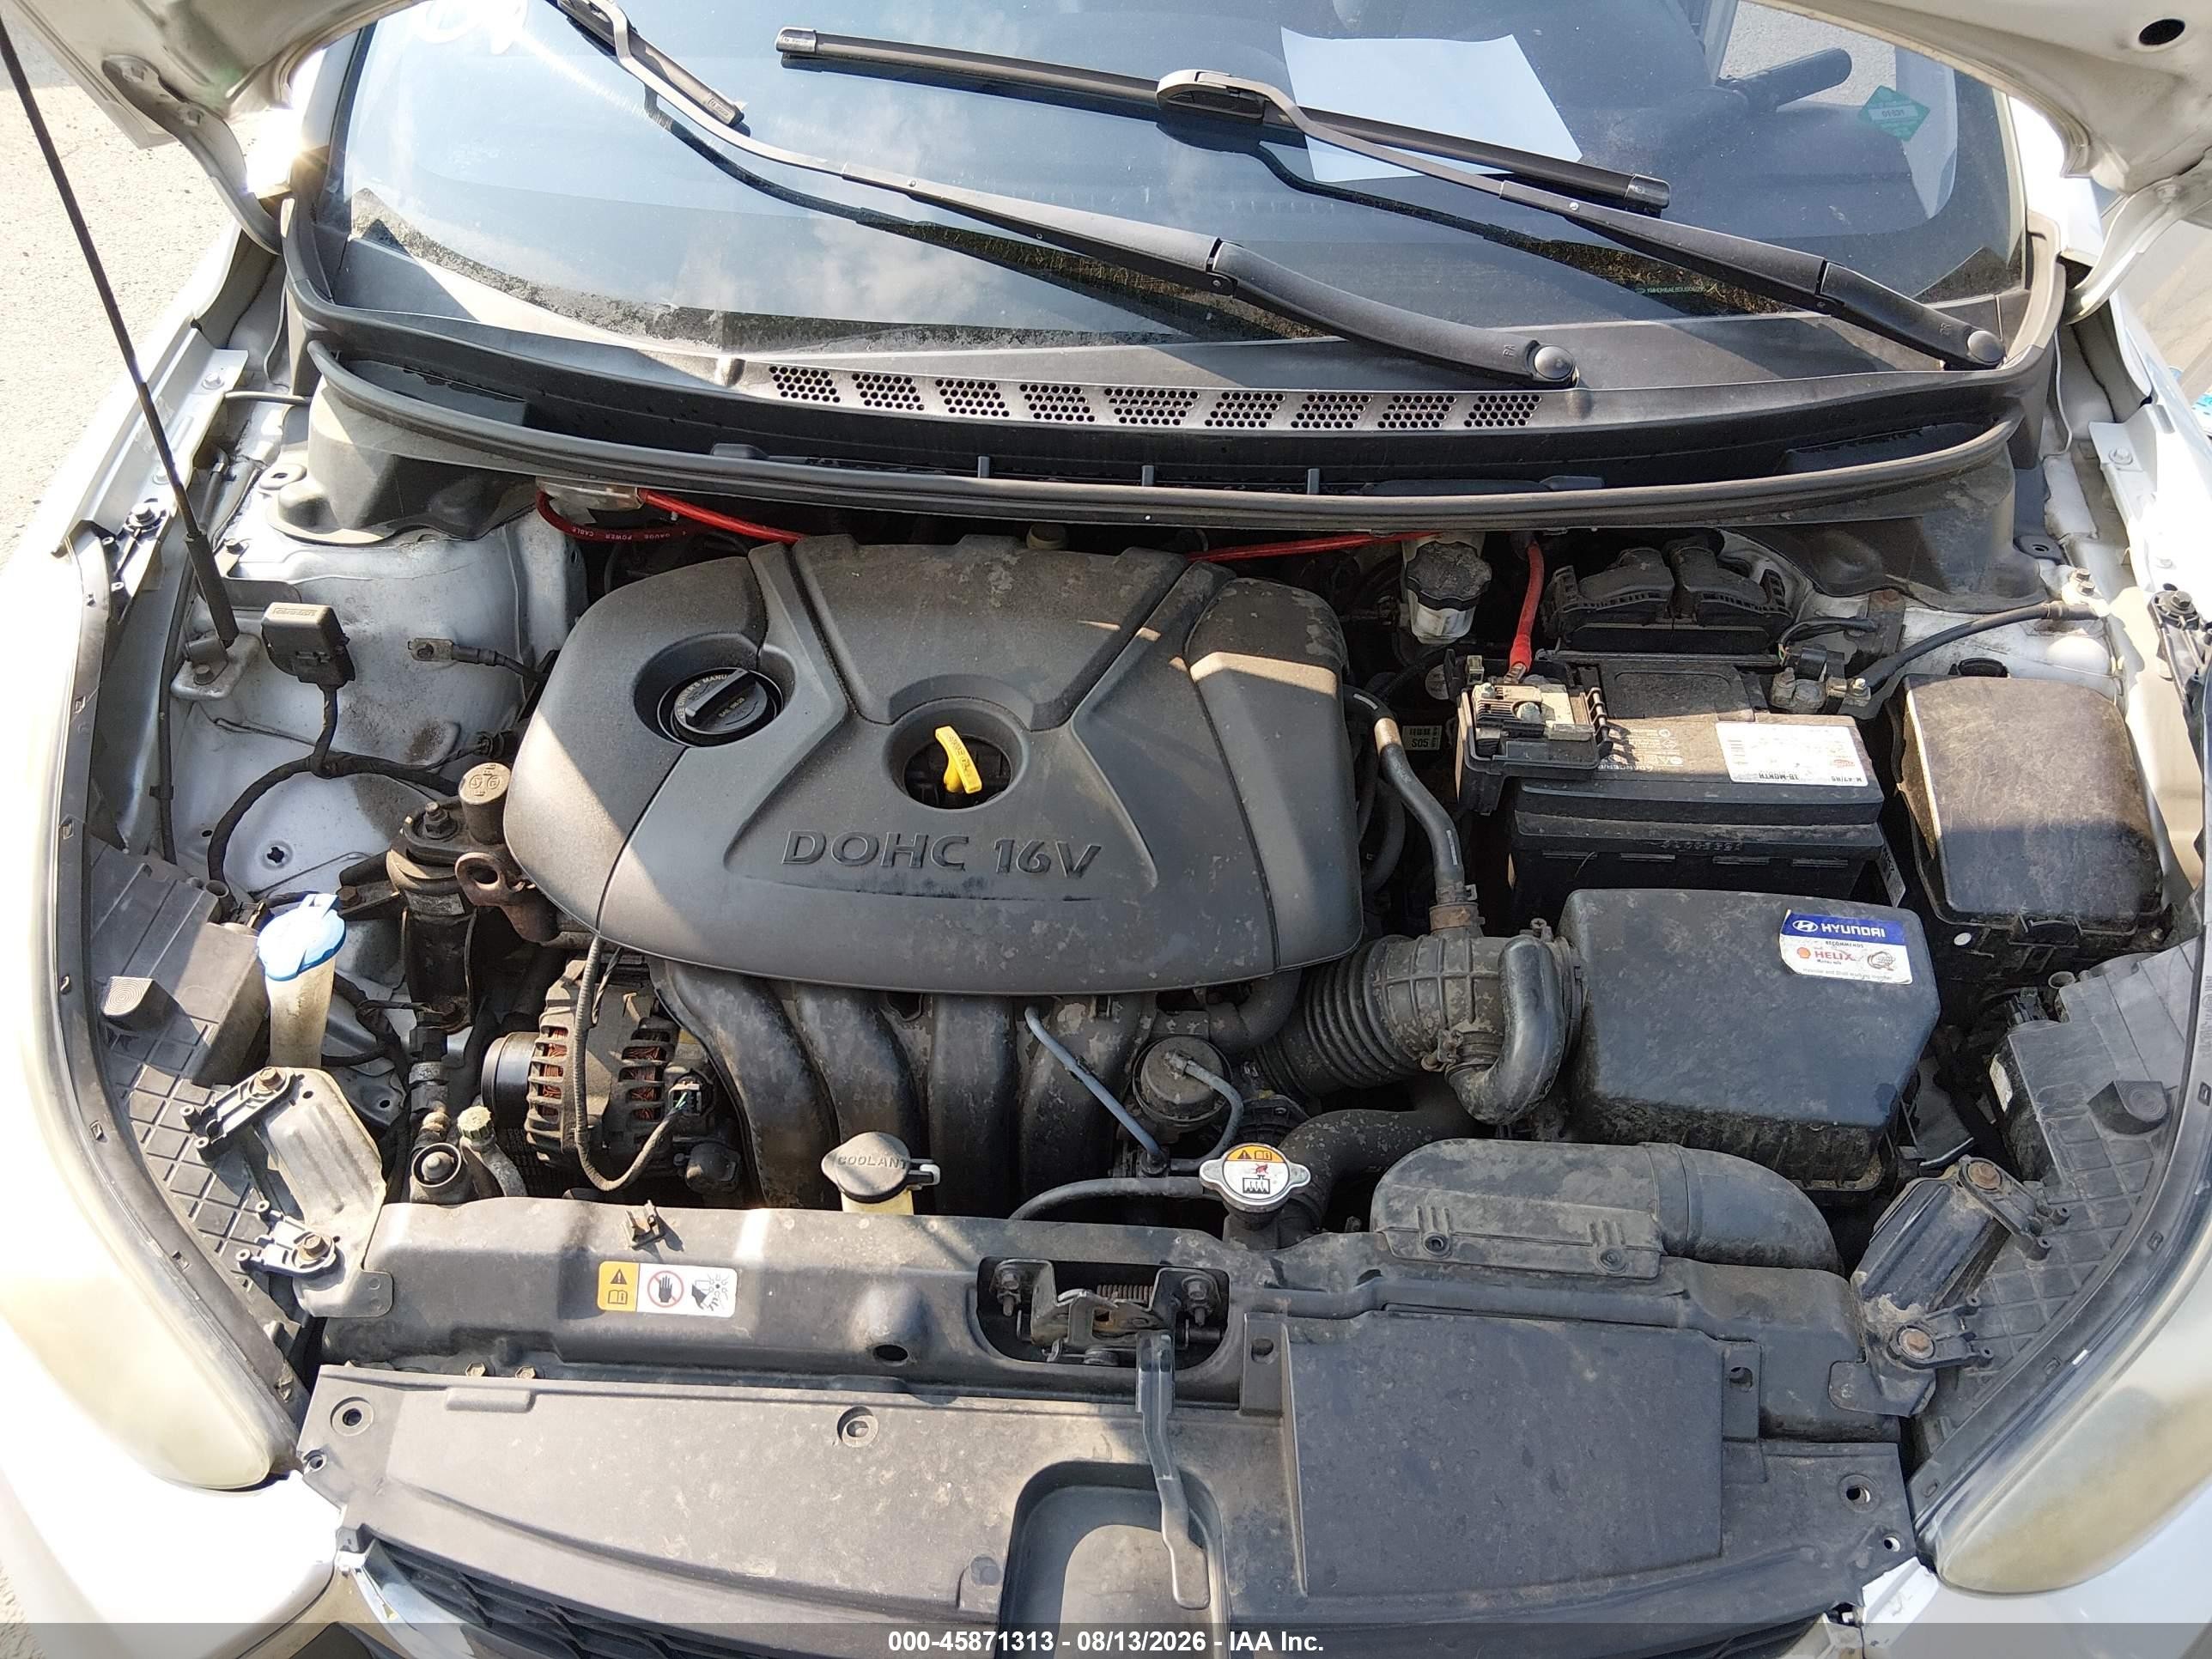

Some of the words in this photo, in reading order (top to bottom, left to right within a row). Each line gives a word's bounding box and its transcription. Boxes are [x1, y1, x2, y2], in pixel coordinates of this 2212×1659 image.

[572, 526, 594, 537] CABLE
[781, 830, 969, 872] DOHC
[994, 837, 1102, 879] 16V
[1820, 923, 1886, 938] HYUNDAI
[1825, 940, 1863, 949] RECOMMENDS
[1814, 951, 1854, 961] HELIX
[837, 1155, 907, 1170] COOLANT
